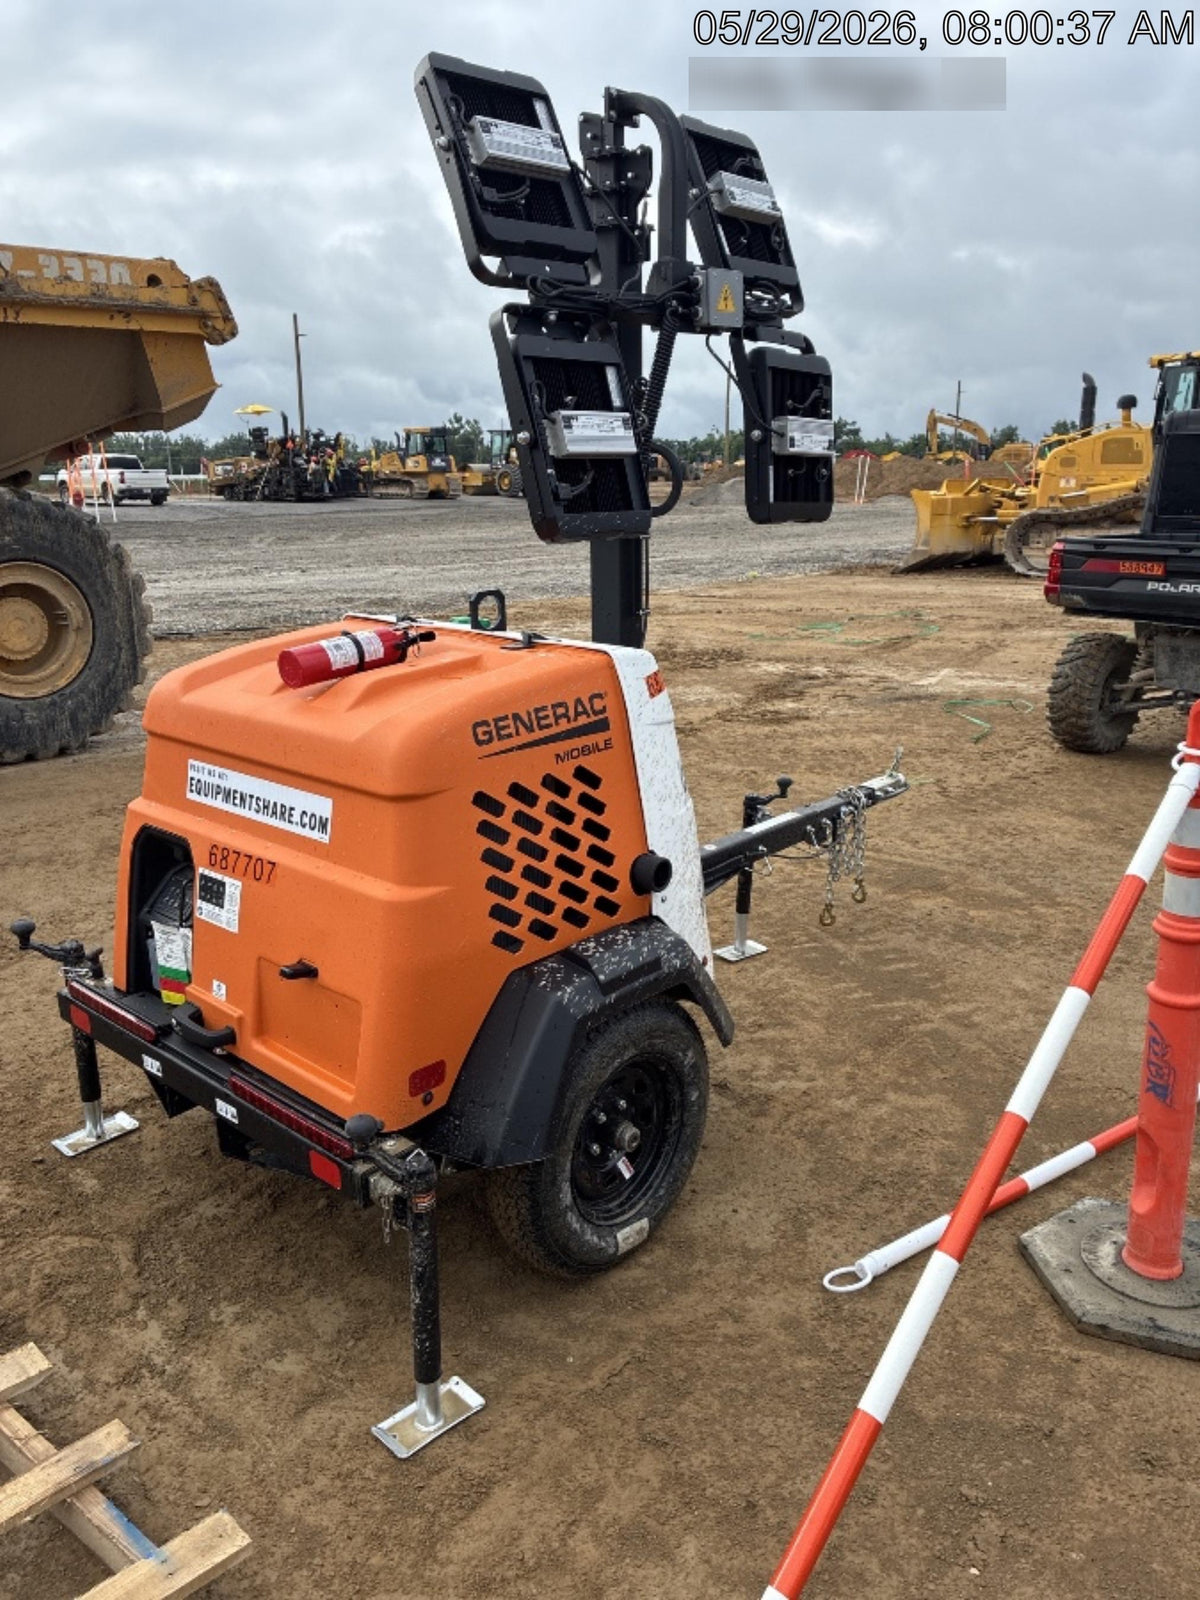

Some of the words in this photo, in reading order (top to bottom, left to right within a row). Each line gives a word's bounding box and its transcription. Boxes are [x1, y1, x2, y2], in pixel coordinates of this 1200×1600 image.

[471, 692, 607, 747] GENERAC
[555, 738, 613, 765] MOBILE
[189, 776, 330, 836] EQUIPMENTSHARE.COM
[209, 844, 277, 884] 687707
